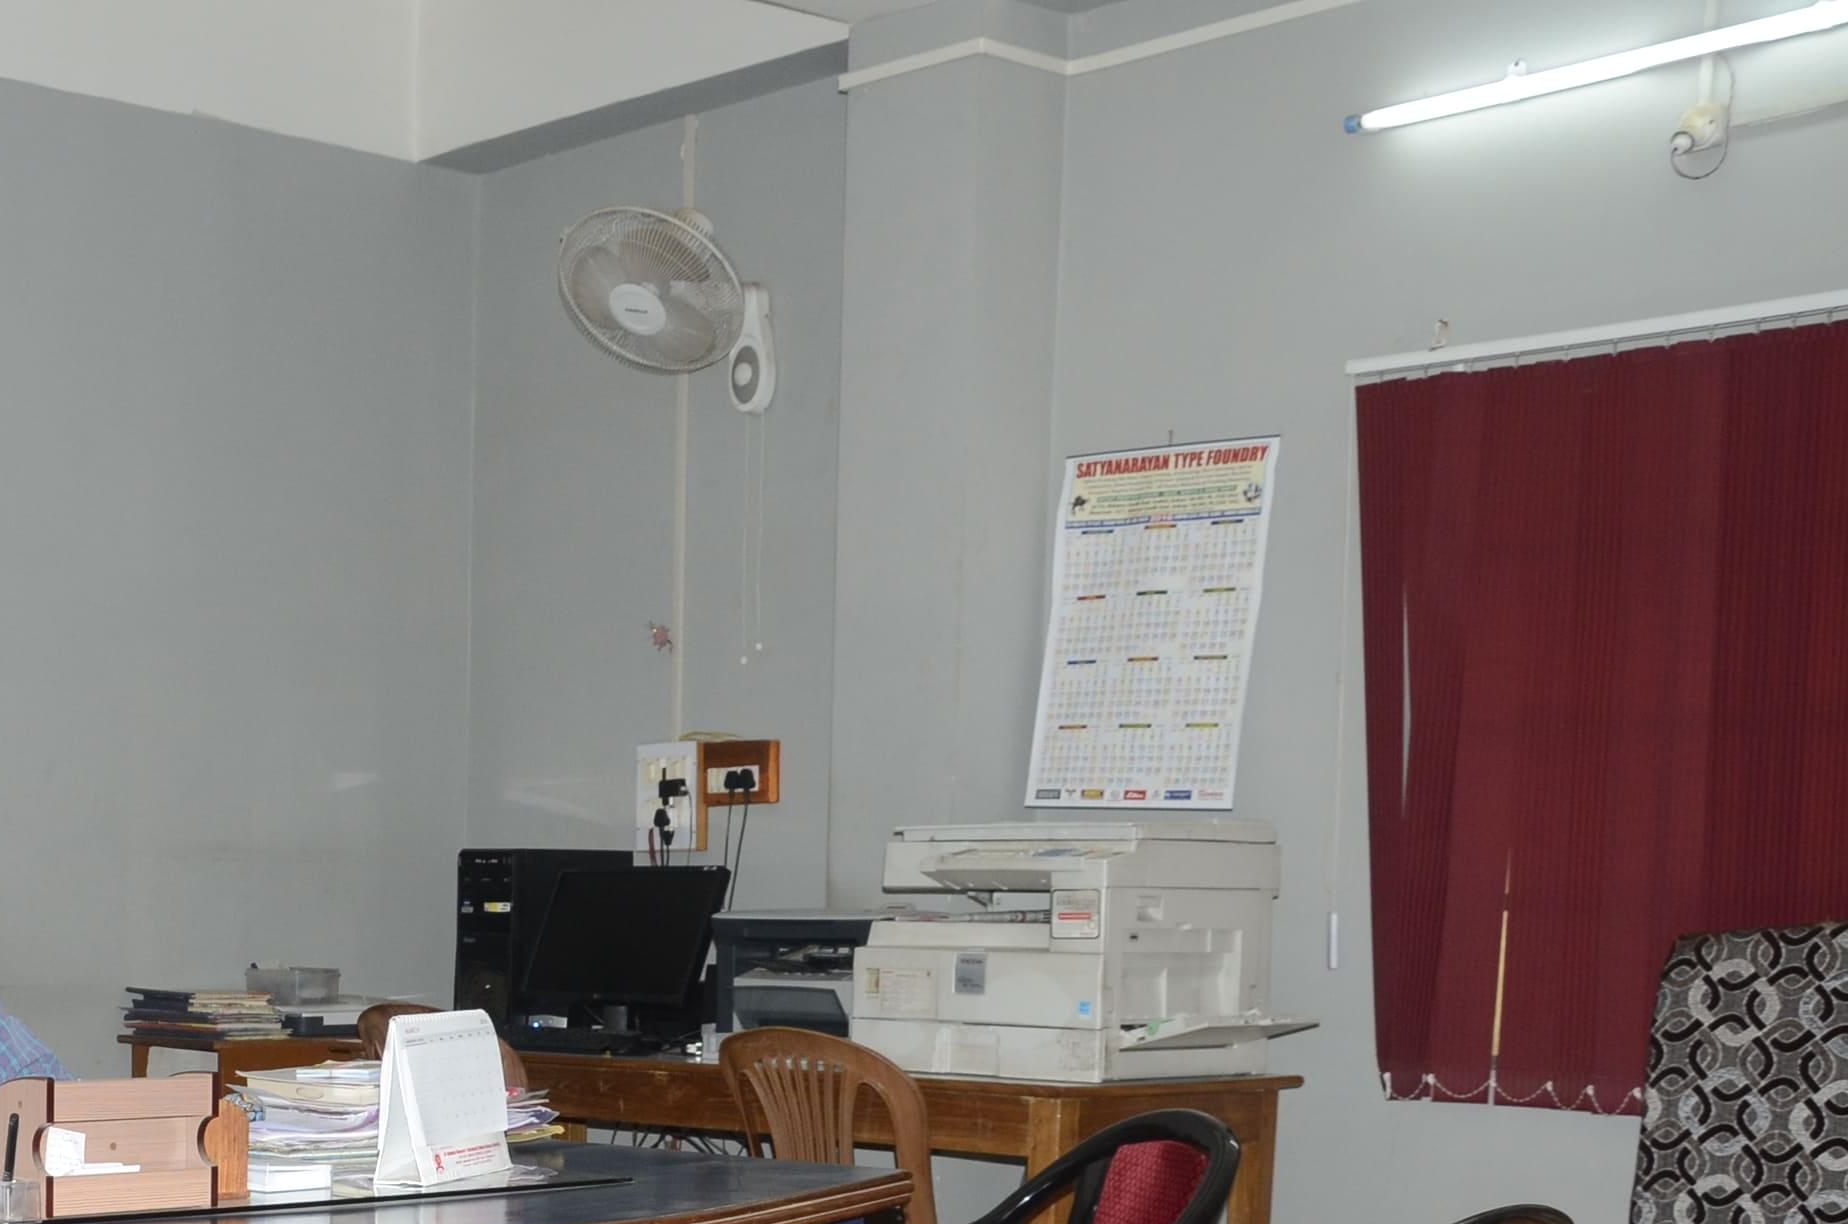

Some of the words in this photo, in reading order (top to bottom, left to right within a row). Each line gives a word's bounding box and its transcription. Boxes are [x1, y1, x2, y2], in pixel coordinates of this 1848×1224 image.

[1076, 453, 1170, 479] SATYANARAYAN
[1173, 450, 1204, 470] TYPE
[1205, 445, 1269, 466] FOUNDRY
